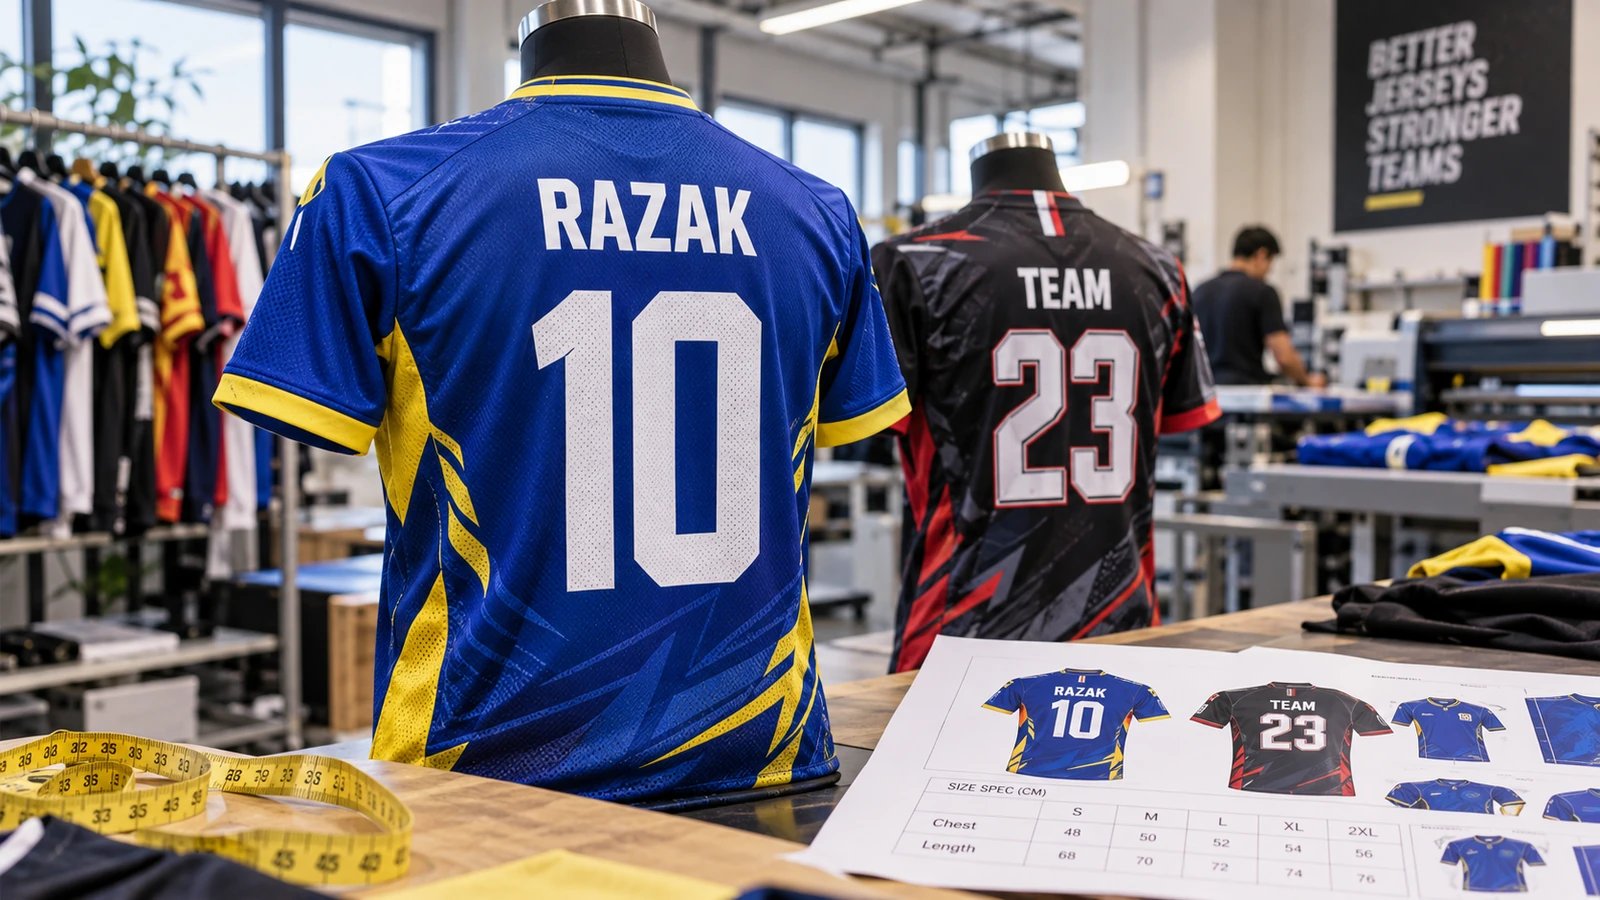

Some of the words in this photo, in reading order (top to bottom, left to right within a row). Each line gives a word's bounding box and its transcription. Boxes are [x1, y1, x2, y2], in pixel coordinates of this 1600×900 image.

[1367, 20, 1476, 78] BETTER
[1365, 58, 1489, 116] JERSEYS
[1365, 94, 1522, 152] STRONGER
[1367, 143, 1463, 192] TEAMS
[537, 178, 757, 256] RAZAK
[1017, 267, 1112, 310] TEAM
[992, 328, 1140, 509] 23
[532, 290, 762, 592] 10
[1053, 686, 1107, 698] RAZAK
[1270, 699, 1316, 711] TEAM
[1051, 699, 1105, 740] 10
[1259, 712, 1327, 751] 23
[100, 742, 116, 755] 35
[948, 782, 976, 792] SIZE
[980, 784, 1014, 795] SPEC
[1018, 786, 1046, 798] (CM)
[932, 818, 977, 830] Chest
[1064, 828, 1082, 837] 48
[1139, 832, 1157, 842] 50
[1213, 838, 1230, 848] 52
[1284, 844, 1302, 853] 54
[1356, 849, 1373, 858] 56
[1072, 807, 1082, 817] S
[1144, 812, 1158, 822] M
[1218, 817, 1228, 826] L
[1284, 821, 1304, 832] XL
[1348, 826, 1378, 838] 2XL
[922, 840, 976, 854] Length
[1058, 851, 1076, 860] 68
[1136, 856, 1154, 866] 70
[1212, 862, 1229, 872] 72
[1285, 868, 1303, 878] 74
[1356, 874, 1376, 884] 76
